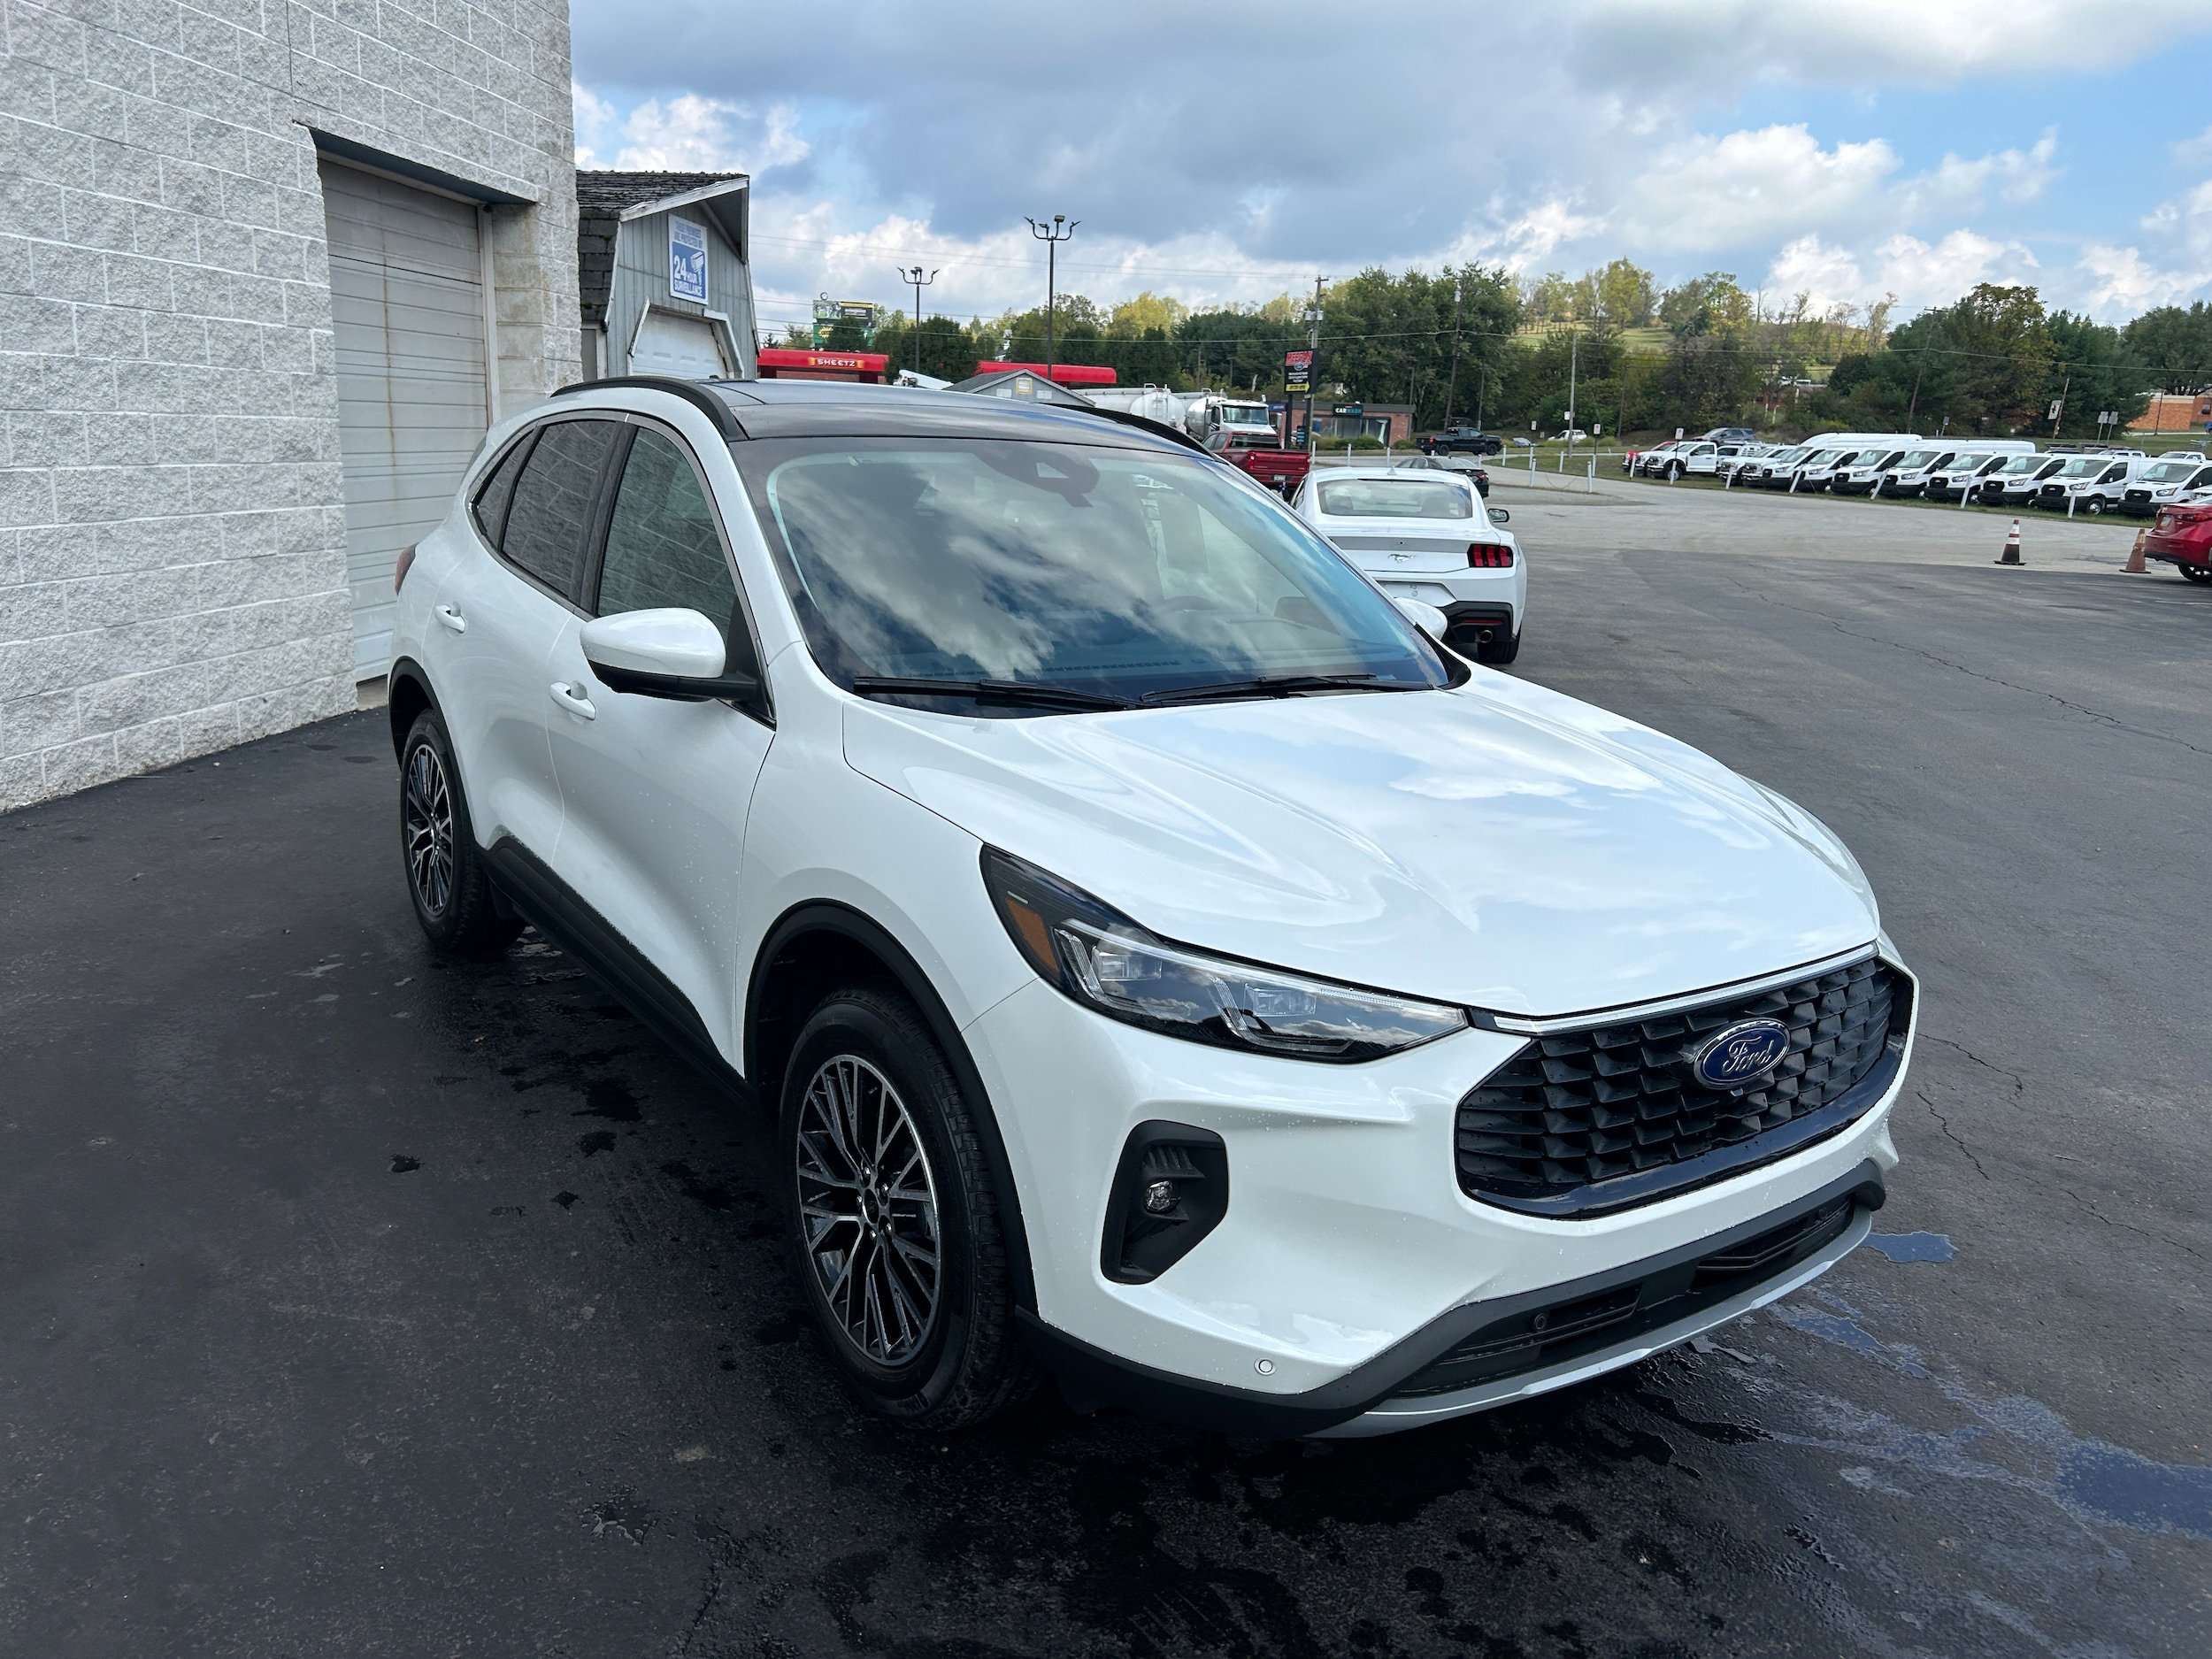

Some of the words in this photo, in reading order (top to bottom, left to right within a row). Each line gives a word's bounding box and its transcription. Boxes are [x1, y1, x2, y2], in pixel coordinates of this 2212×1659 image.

[673, 255, 687, 281] 24
[687, 272, 698, 284] HOUR
[673, 279, 703, 297] SURVEILLANCE
[817, 358, 856, 367] SHEETZ
[1722, 1035, 1775, 1077] Ford
